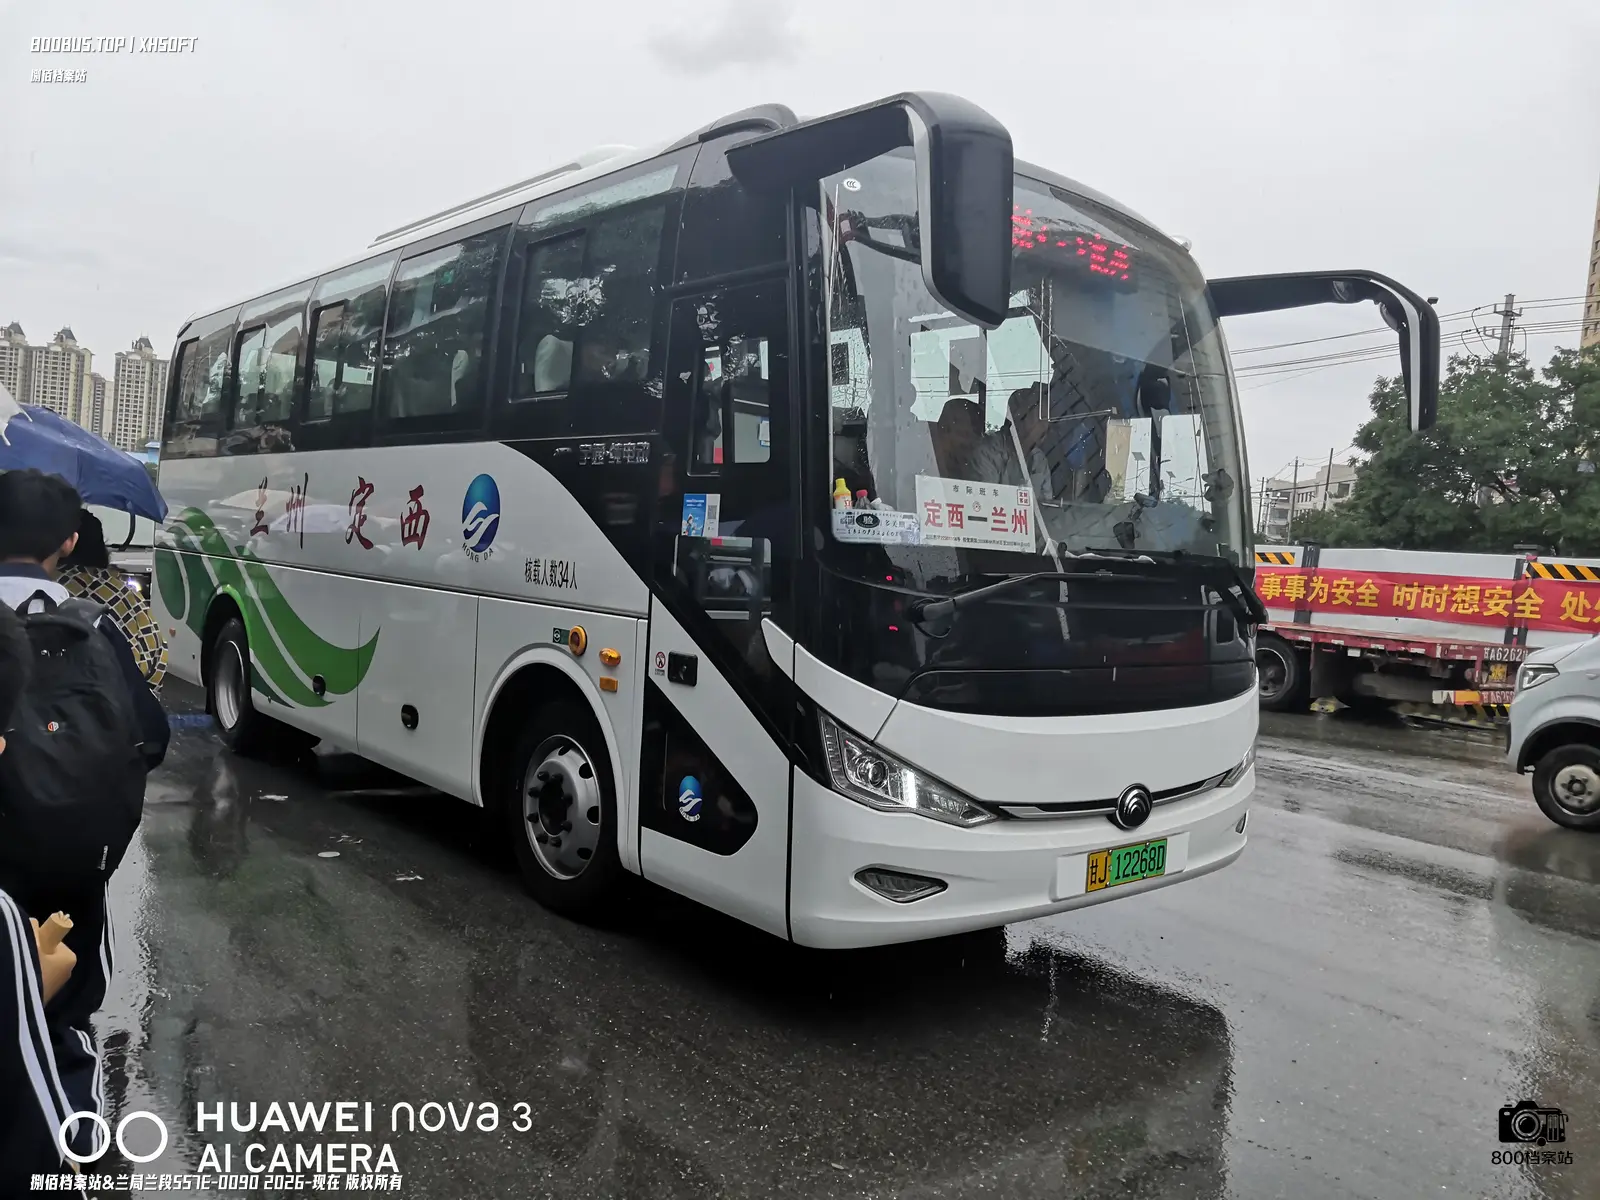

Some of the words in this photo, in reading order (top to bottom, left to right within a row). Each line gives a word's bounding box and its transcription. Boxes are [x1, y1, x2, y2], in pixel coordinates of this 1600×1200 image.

[952, 484, 1000, 498] 市际班车
[345, 476, 431, 551] 定西
[524, 557, 578, 590] 核载人数34人
[1260, 571, 1381, 608] 事事为安全
[1392, 580, 1546, 621] 时时想安全
